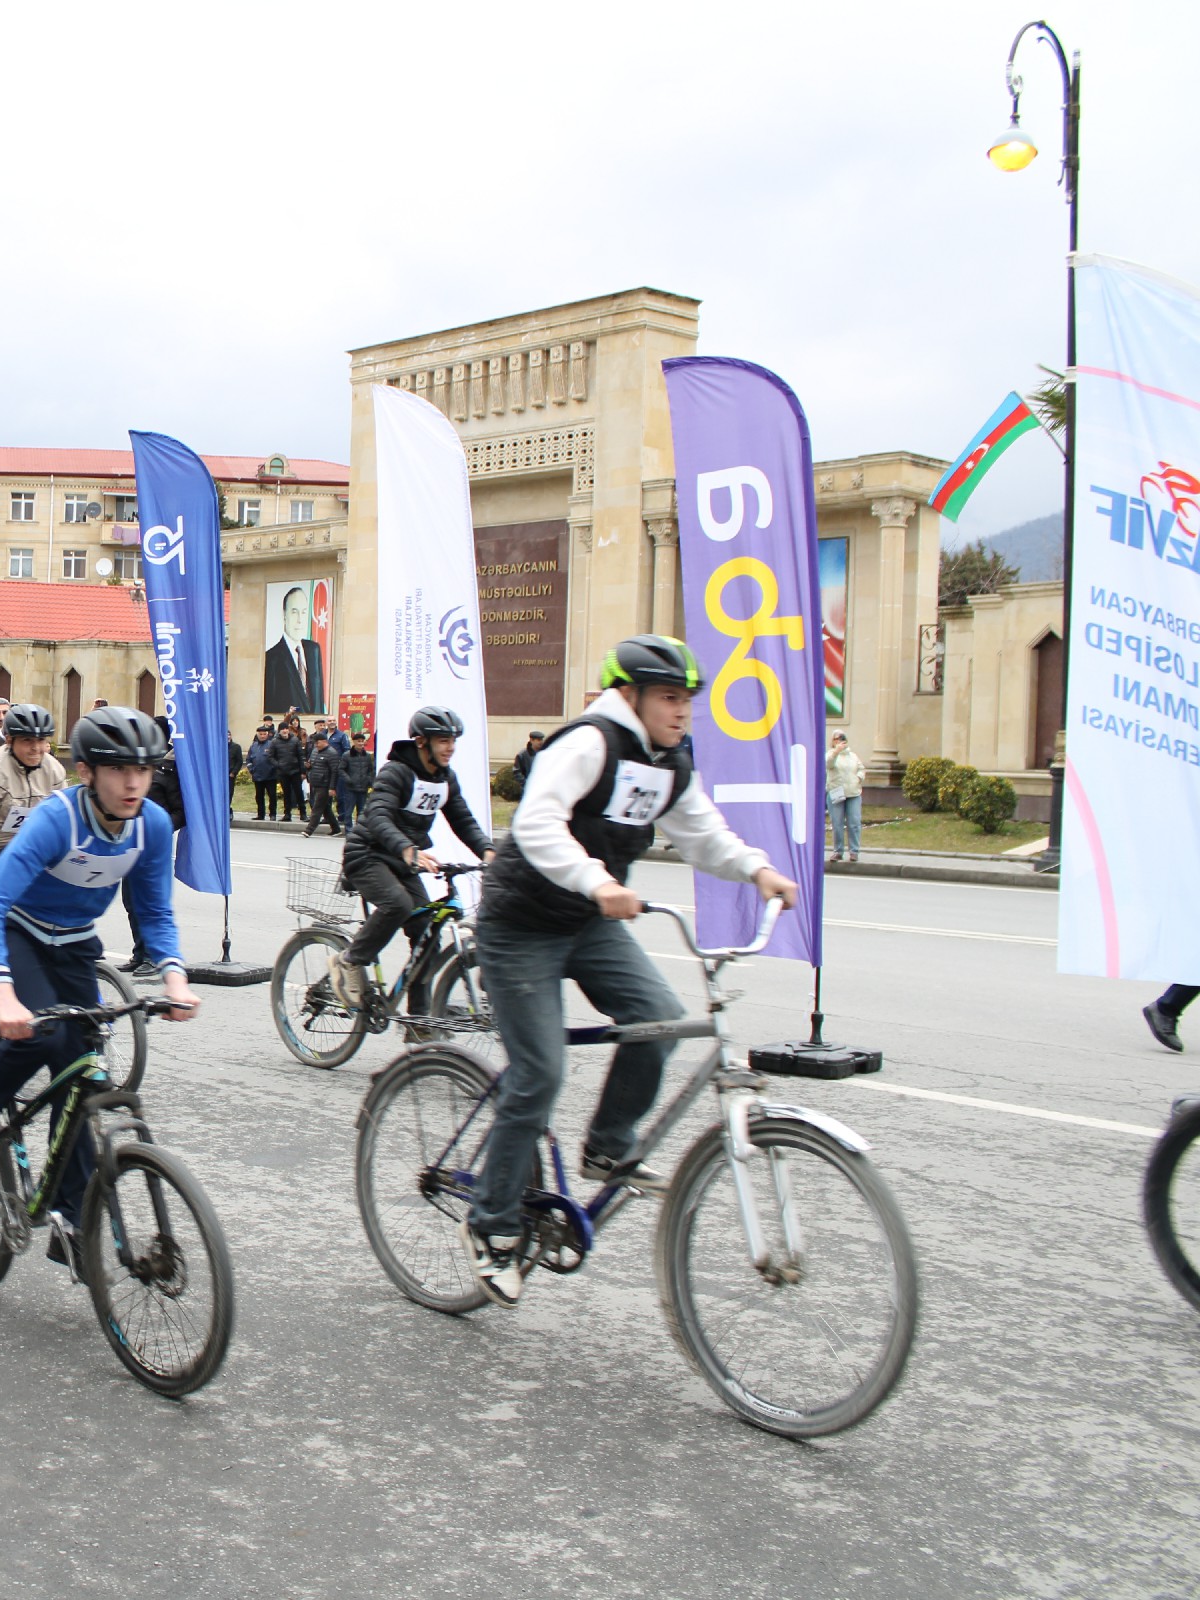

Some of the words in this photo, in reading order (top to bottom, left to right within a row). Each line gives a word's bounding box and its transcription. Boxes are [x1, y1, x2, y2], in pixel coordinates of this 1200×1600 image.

[476, 560, 557, 576] AZƏRBAYCANIN
[479, 582, 552, 599] MÜSTƏQİLLİYİ
[481, 608, 547, 623] DÖNMƏZDİR,
[486, 631, 541, 646] ƏBƏDİDİR!
[84, 871, 103, 882] 7
